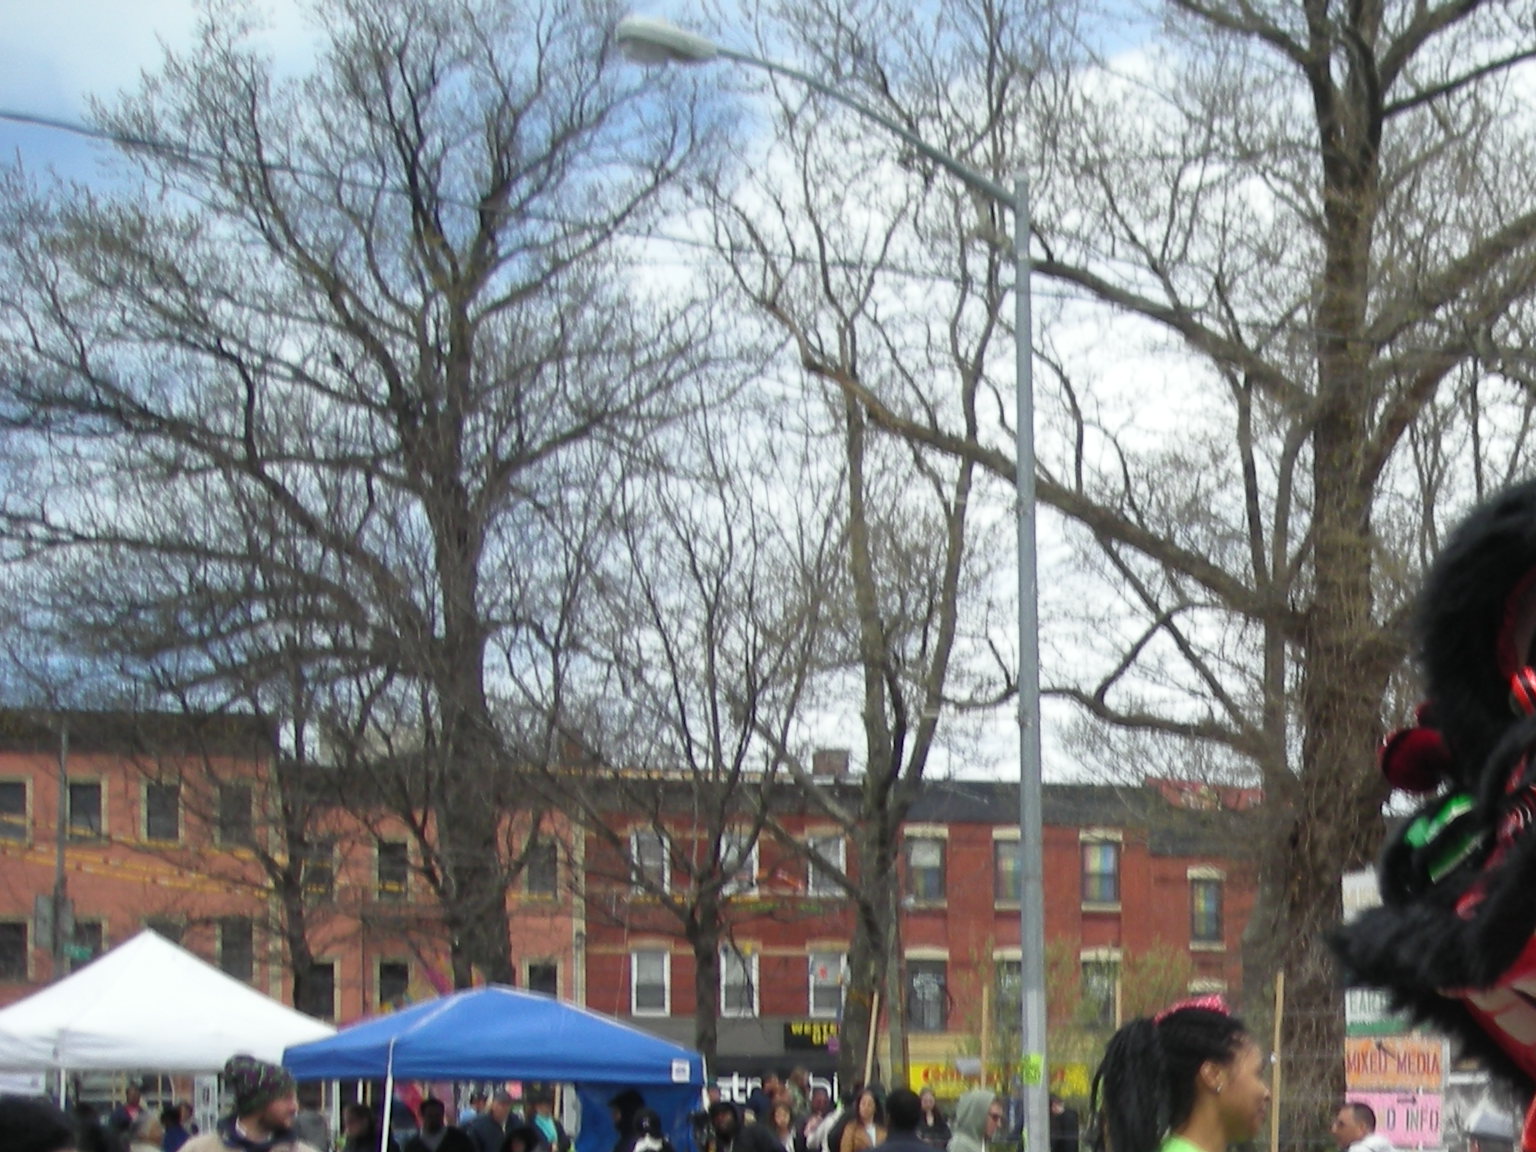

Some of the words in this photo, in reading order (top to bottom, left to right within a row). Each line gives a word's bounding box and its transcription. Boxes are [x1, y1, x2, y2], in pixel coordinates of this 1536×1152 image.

[1347, 1051, 1388, 1074] MIXED
[1397, 1051, 1440, 1074] MEDIA
[1406, 1107, 1440, 1132] INFO
